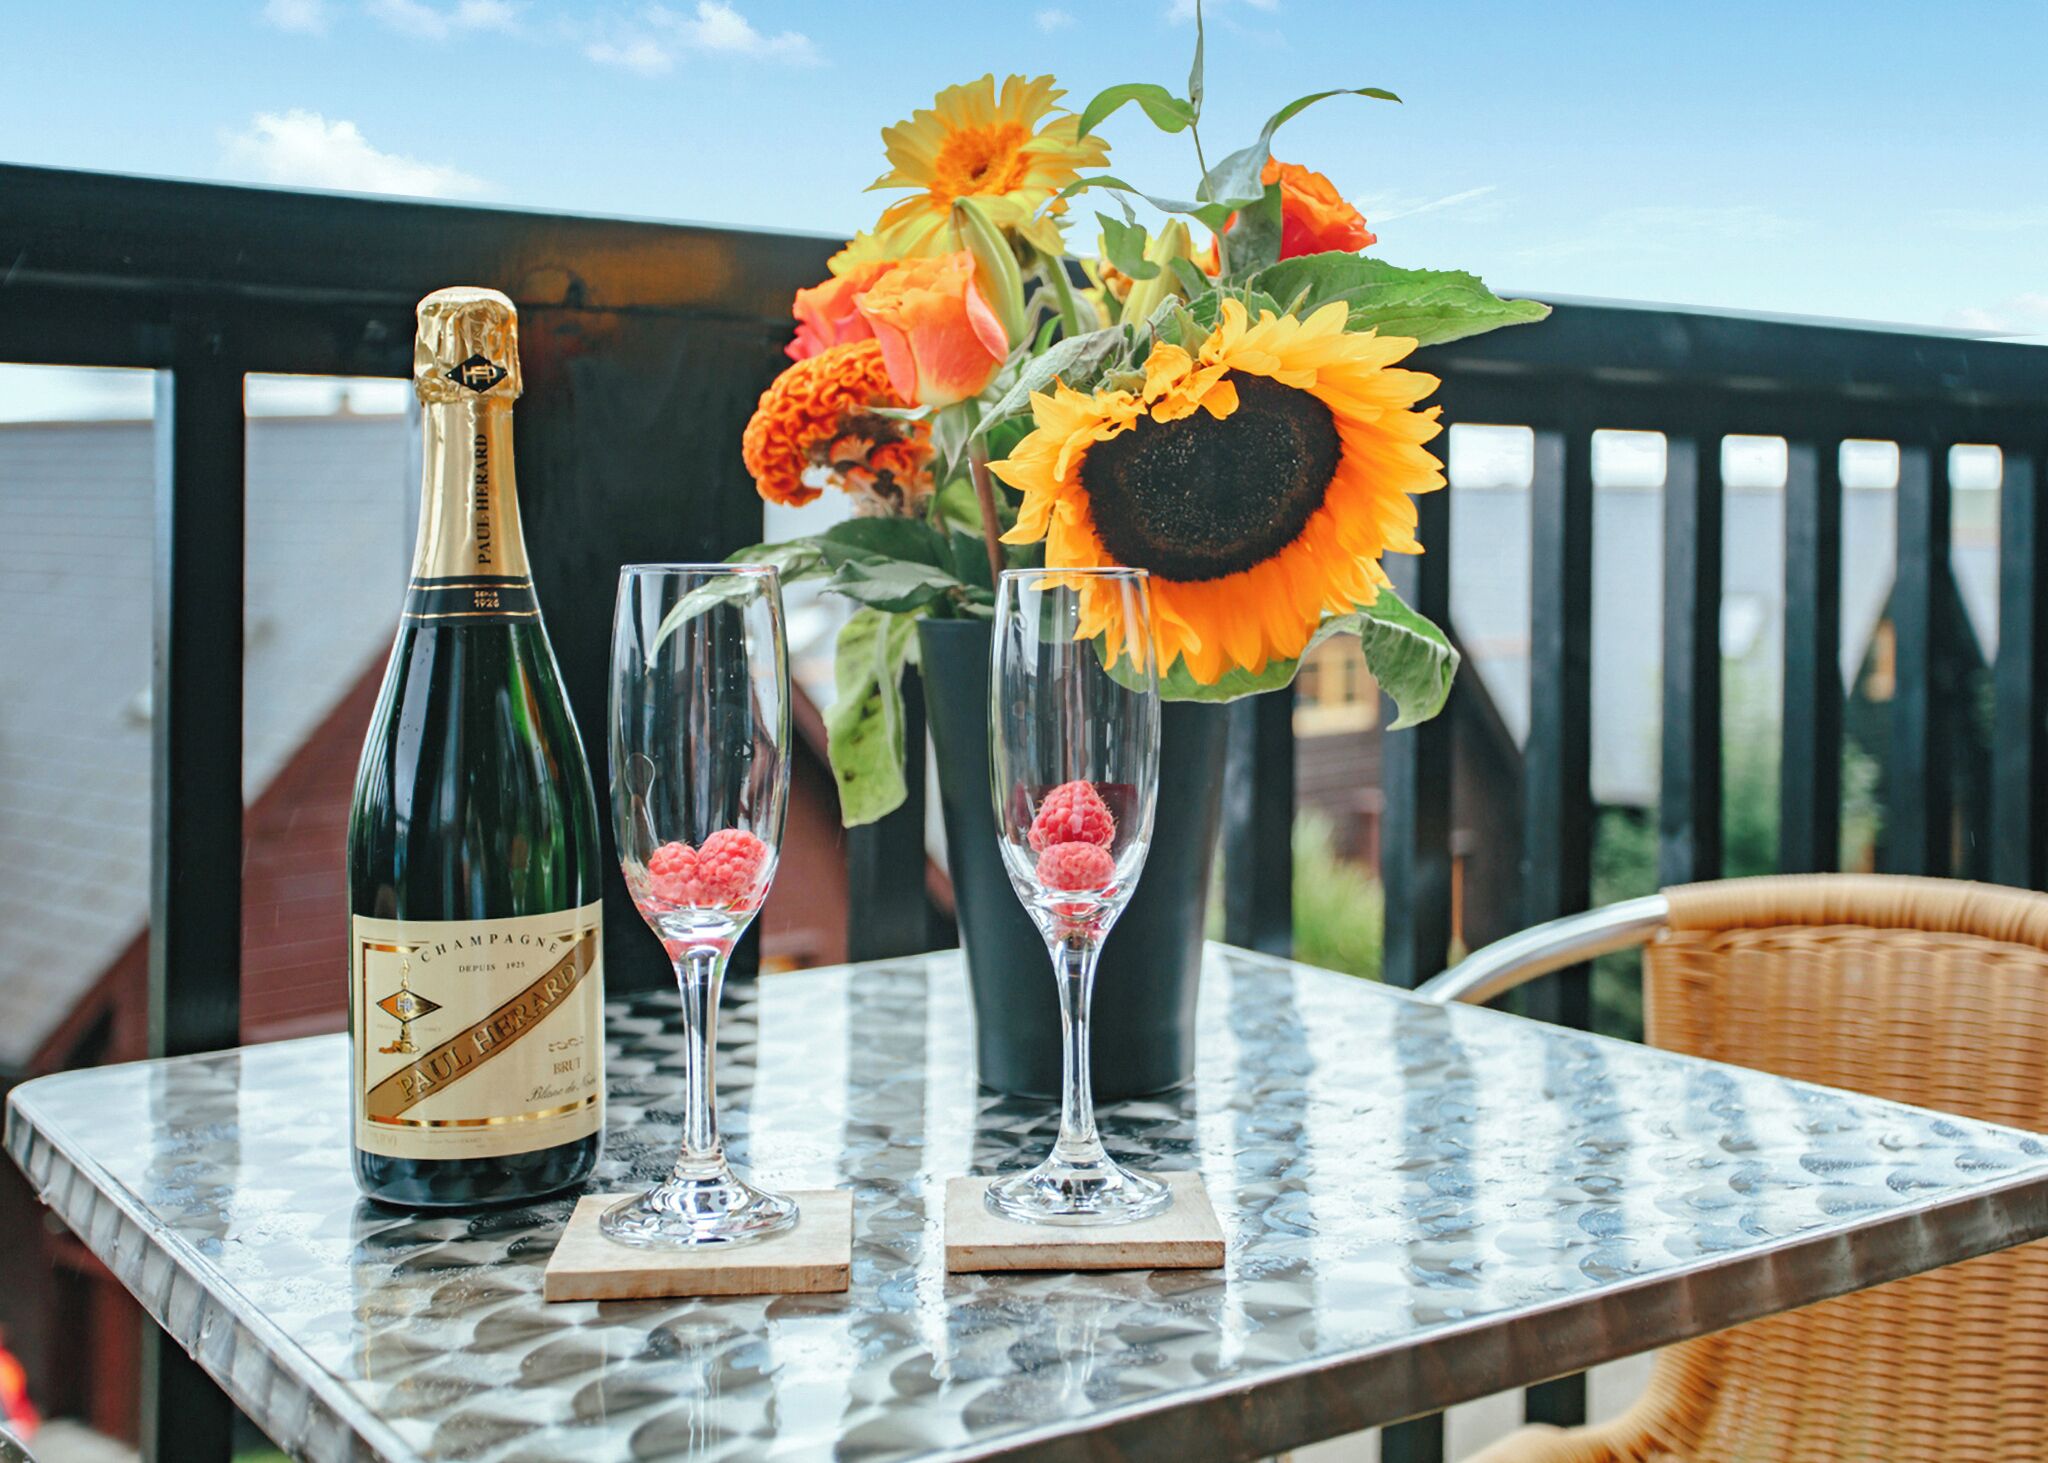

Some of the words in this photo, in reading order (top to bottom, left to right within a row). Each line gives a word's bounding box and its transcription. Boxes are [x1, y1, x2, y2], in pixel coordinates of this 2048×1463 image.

[474, 433, 489, 511] HERARD
[476, 515, 492, 565] PAUL
[420, 932, 559, 964] CHAMPAGNE
[458, 963, 497, 973] DEPUIS
[400, 1046, 474, 1102] PAUL
[471, 963, 578, 1058] HERARD
[553, 1056, 581, 1074] BRUT
